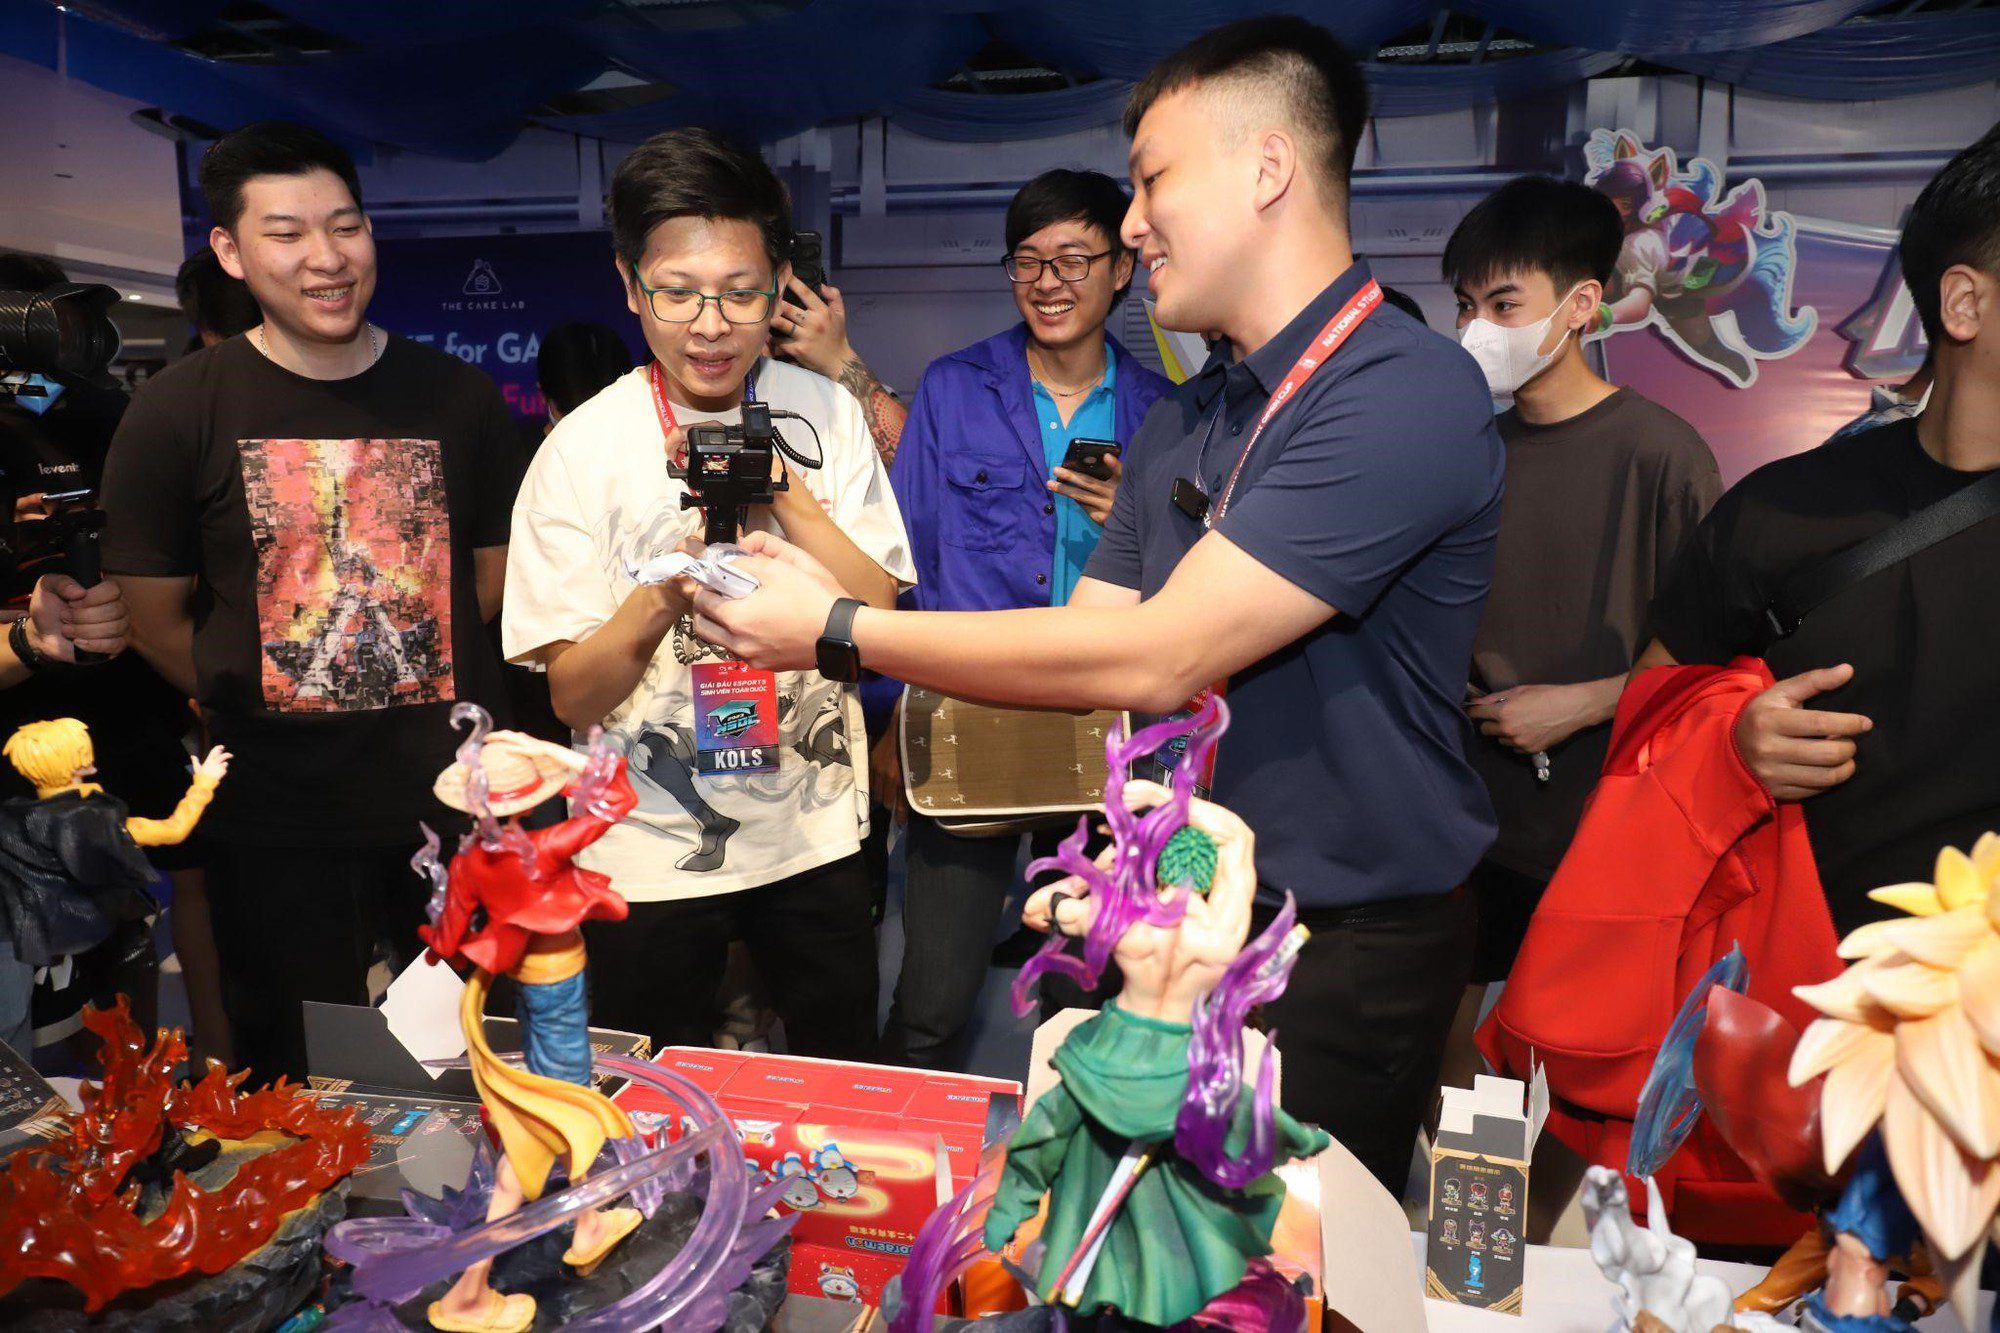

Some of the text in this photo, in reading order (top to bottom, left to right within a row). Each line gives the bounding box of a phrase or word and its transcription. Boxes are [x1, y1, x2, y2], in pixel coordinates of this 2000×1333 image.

[442, 301, 525, 311] THE CAKE LAB
[1322, 306, 1362, 347] NATIONAL
[1277, 380, 1294, 400] CUP
[714, 748, 763, 770] KOLS
